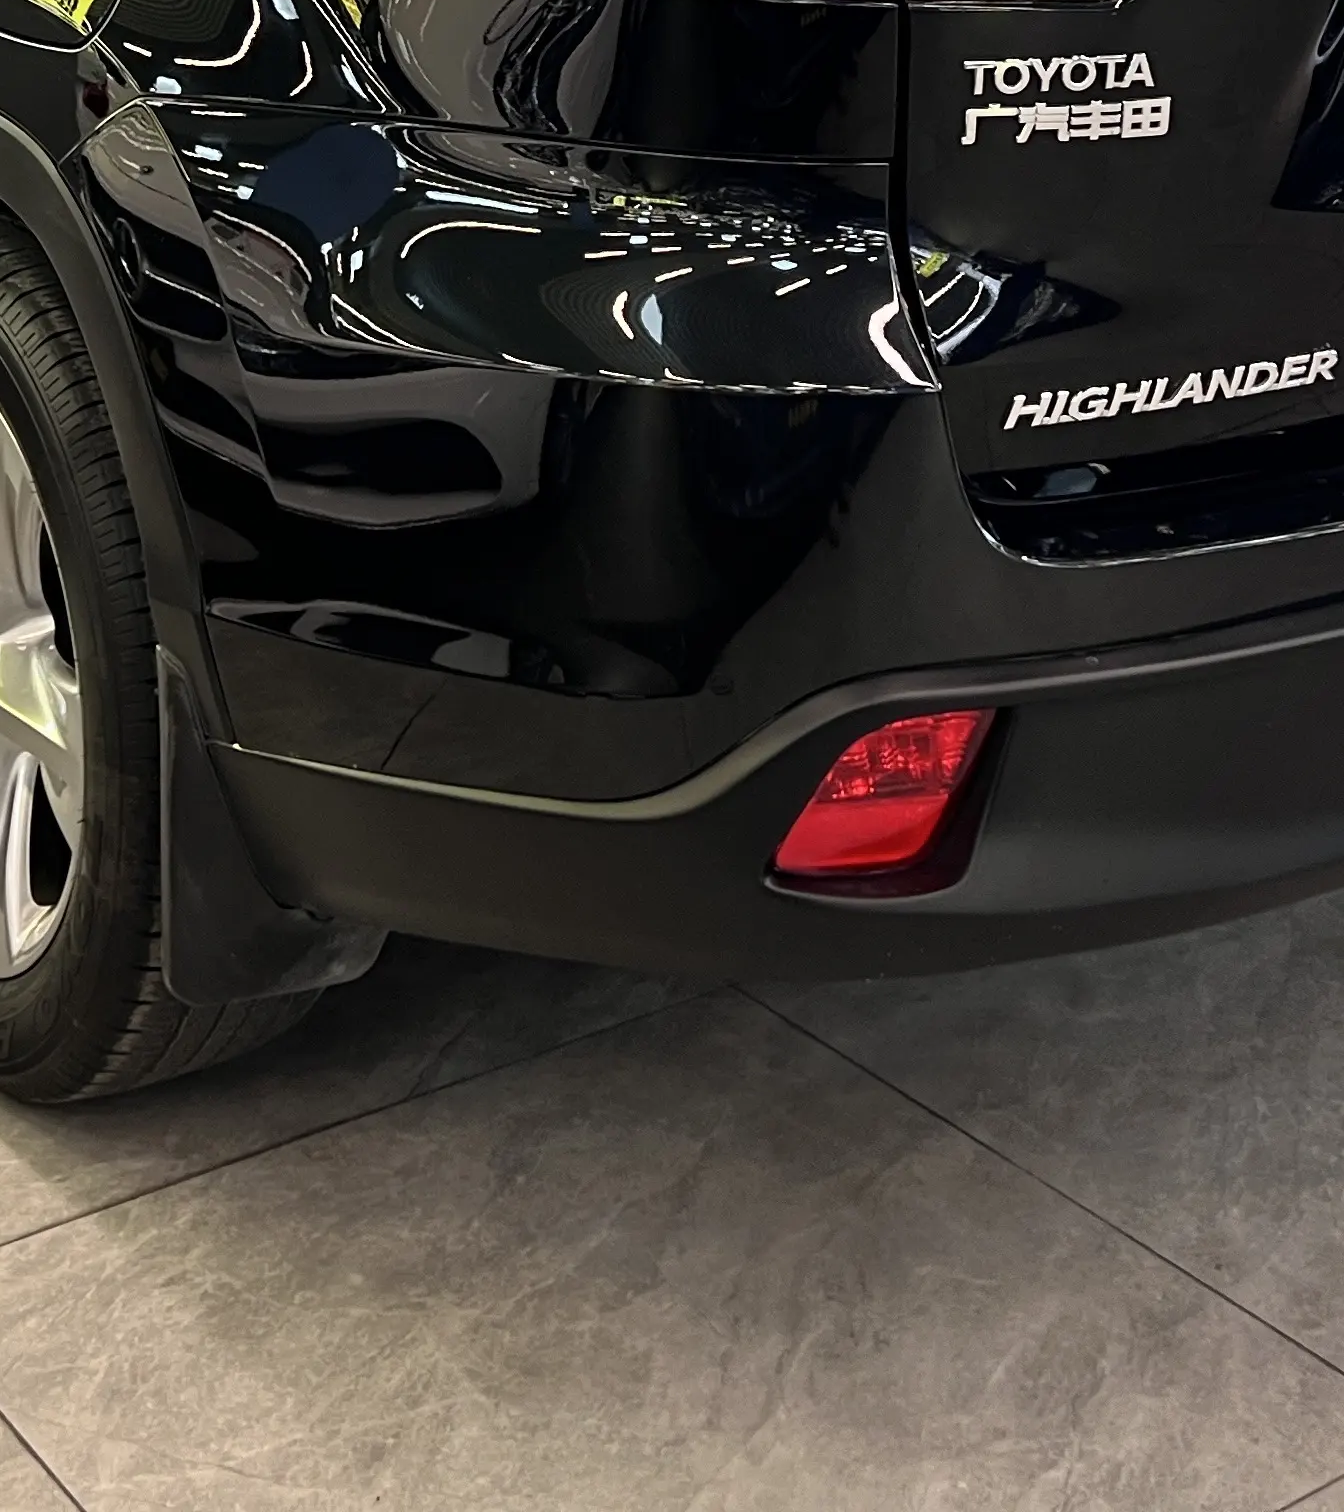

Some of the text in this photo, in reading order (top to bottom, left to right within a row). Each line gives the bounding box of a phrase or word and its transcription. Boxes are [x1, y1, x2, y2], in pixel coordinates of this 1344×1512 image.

[963, 52, 1155, 95] TOYOTA
[960, 96, 1172, 145] 广汽丰田
[1002, 345, 1339, 430] HIGHLANDER
